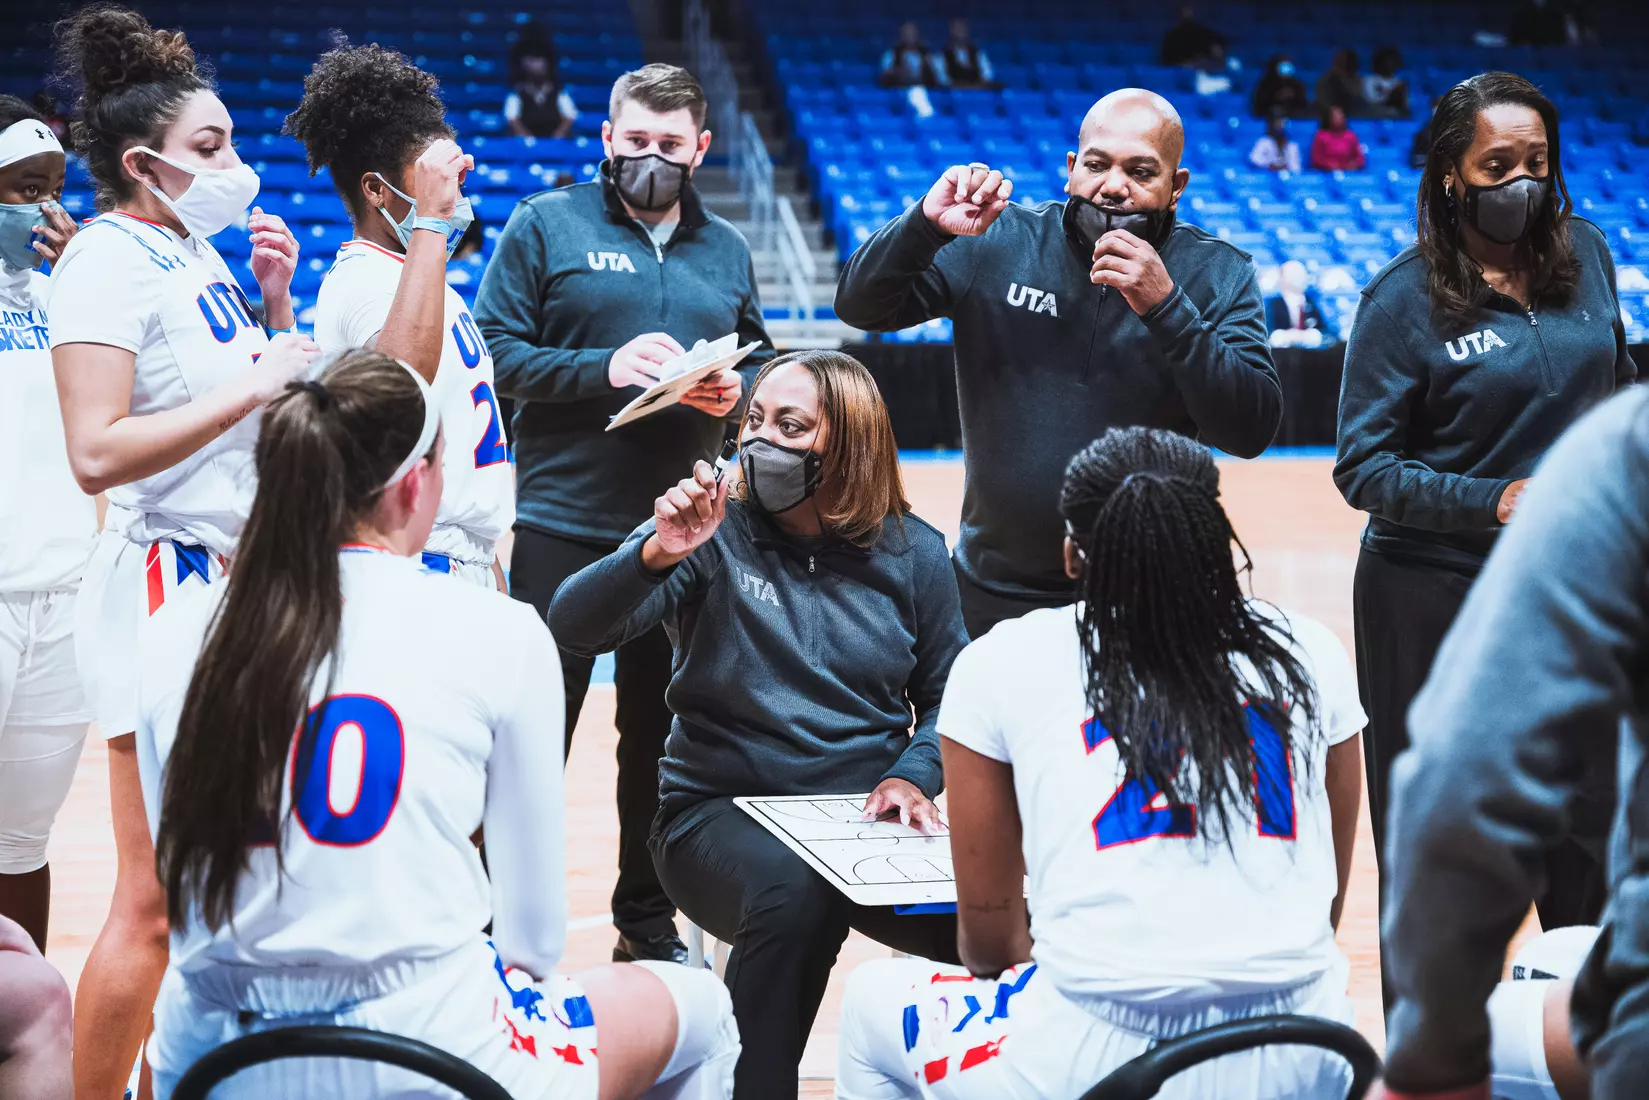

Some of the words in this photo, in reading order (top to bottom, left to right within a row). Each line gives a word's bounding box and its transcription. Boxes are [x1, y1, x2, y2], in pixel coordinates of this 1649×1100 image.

[587, 251, 637, 273] UTA
[0, 307, 35, 328] ADY
[1006, 282, 1058, 317] UTA
[451, 312, 491, 369] UT
[1444, 328, 1508, 361] UTA
[470, 380, 513, 469] 2
[736, 566, 780, 607] UTA
[246, 693, 406, 848] 0
